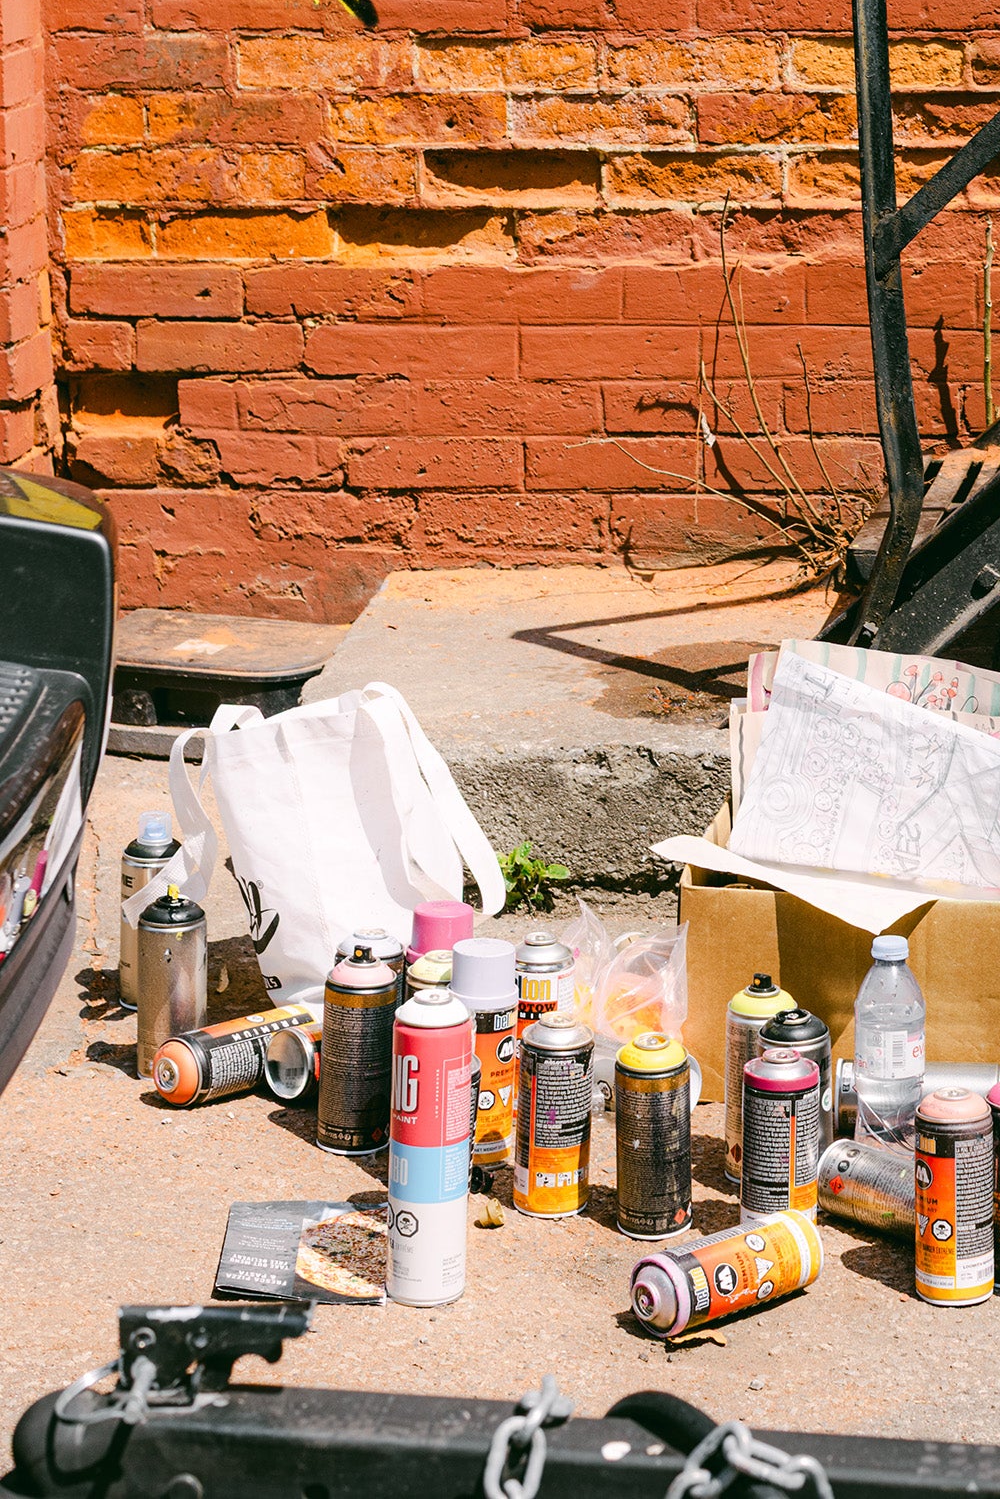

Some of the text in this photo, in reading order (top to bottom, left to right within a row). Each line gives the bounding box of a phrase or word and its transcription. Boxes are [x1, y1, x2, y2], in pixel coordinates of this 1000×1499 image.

[517, 974, 551, 1001] lton
[518, 1003, 556, 1012] OTOW
[231, 1017, 300, 1042] PREMIUM
[225, 1272, 287, 1286] FRESCA PIZZA
[238, 1270, 267, 1279] PASTA
[735, 1252, 748, 1290] REMIUM
